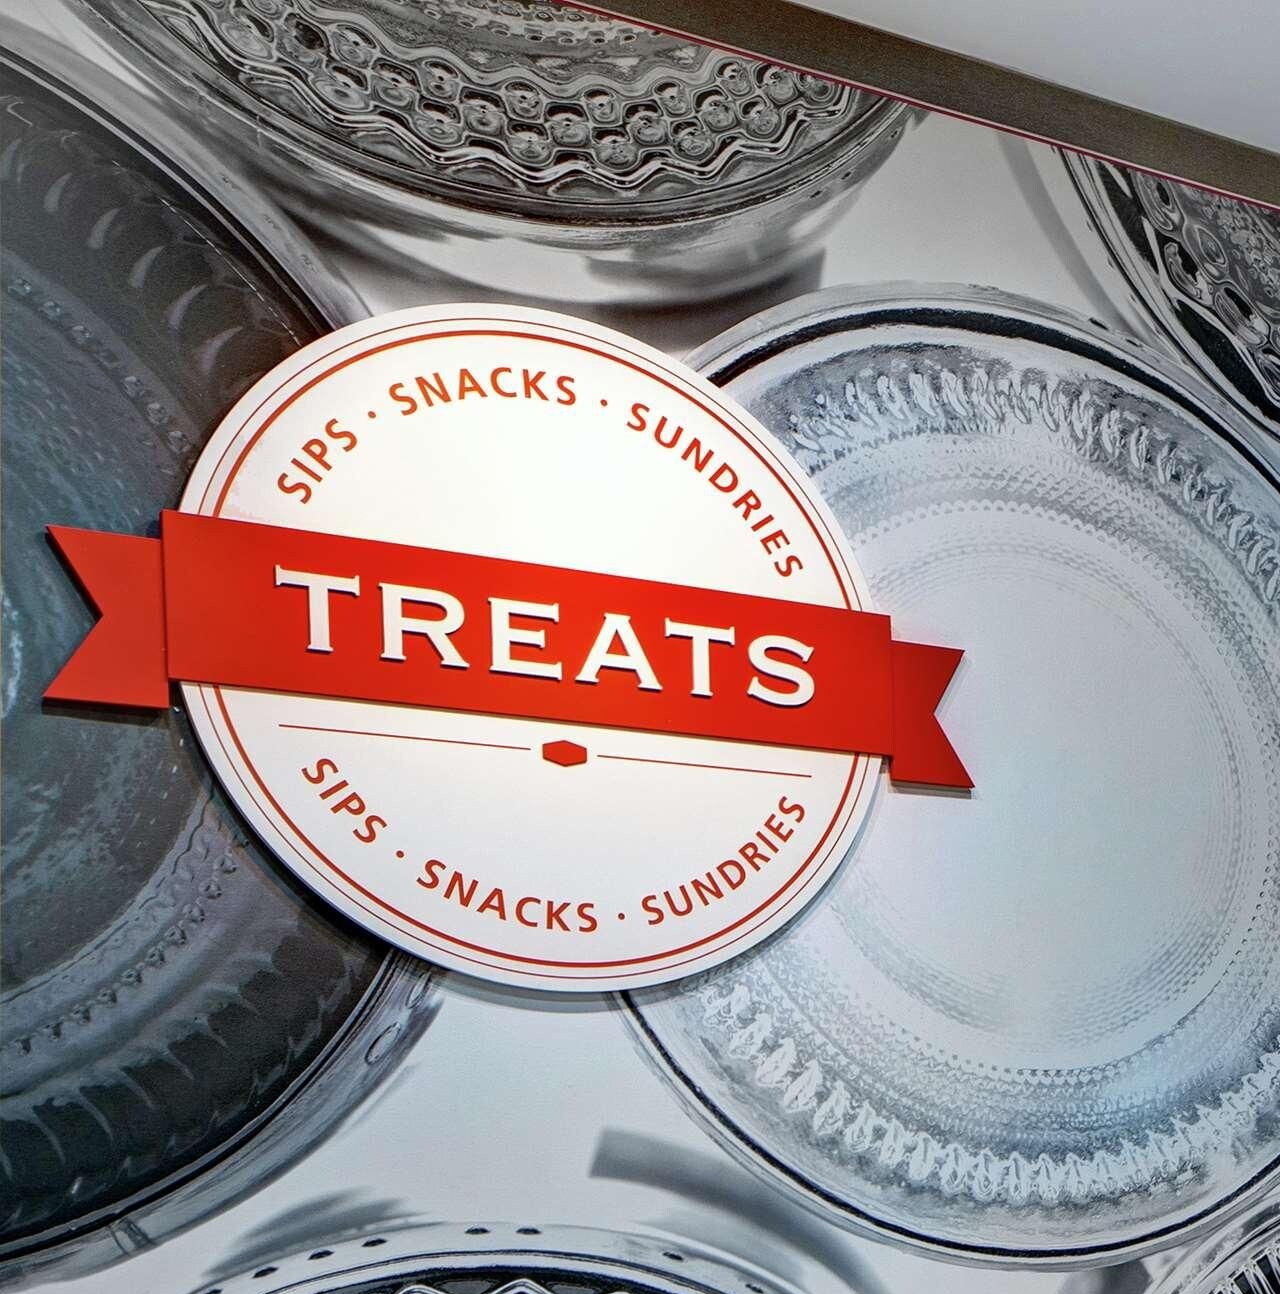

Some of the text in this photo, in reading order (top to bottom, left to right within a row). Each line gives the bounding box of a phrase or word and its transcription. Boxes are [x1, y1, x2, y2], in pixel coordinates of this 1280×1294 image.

[277, 366, 804, 579] SIPS SNACKS SUNDRIES
[273, 564, 817, 708] TREATS
[301, 756, 806, 933] SIPS SNACKS SUNDRIES
